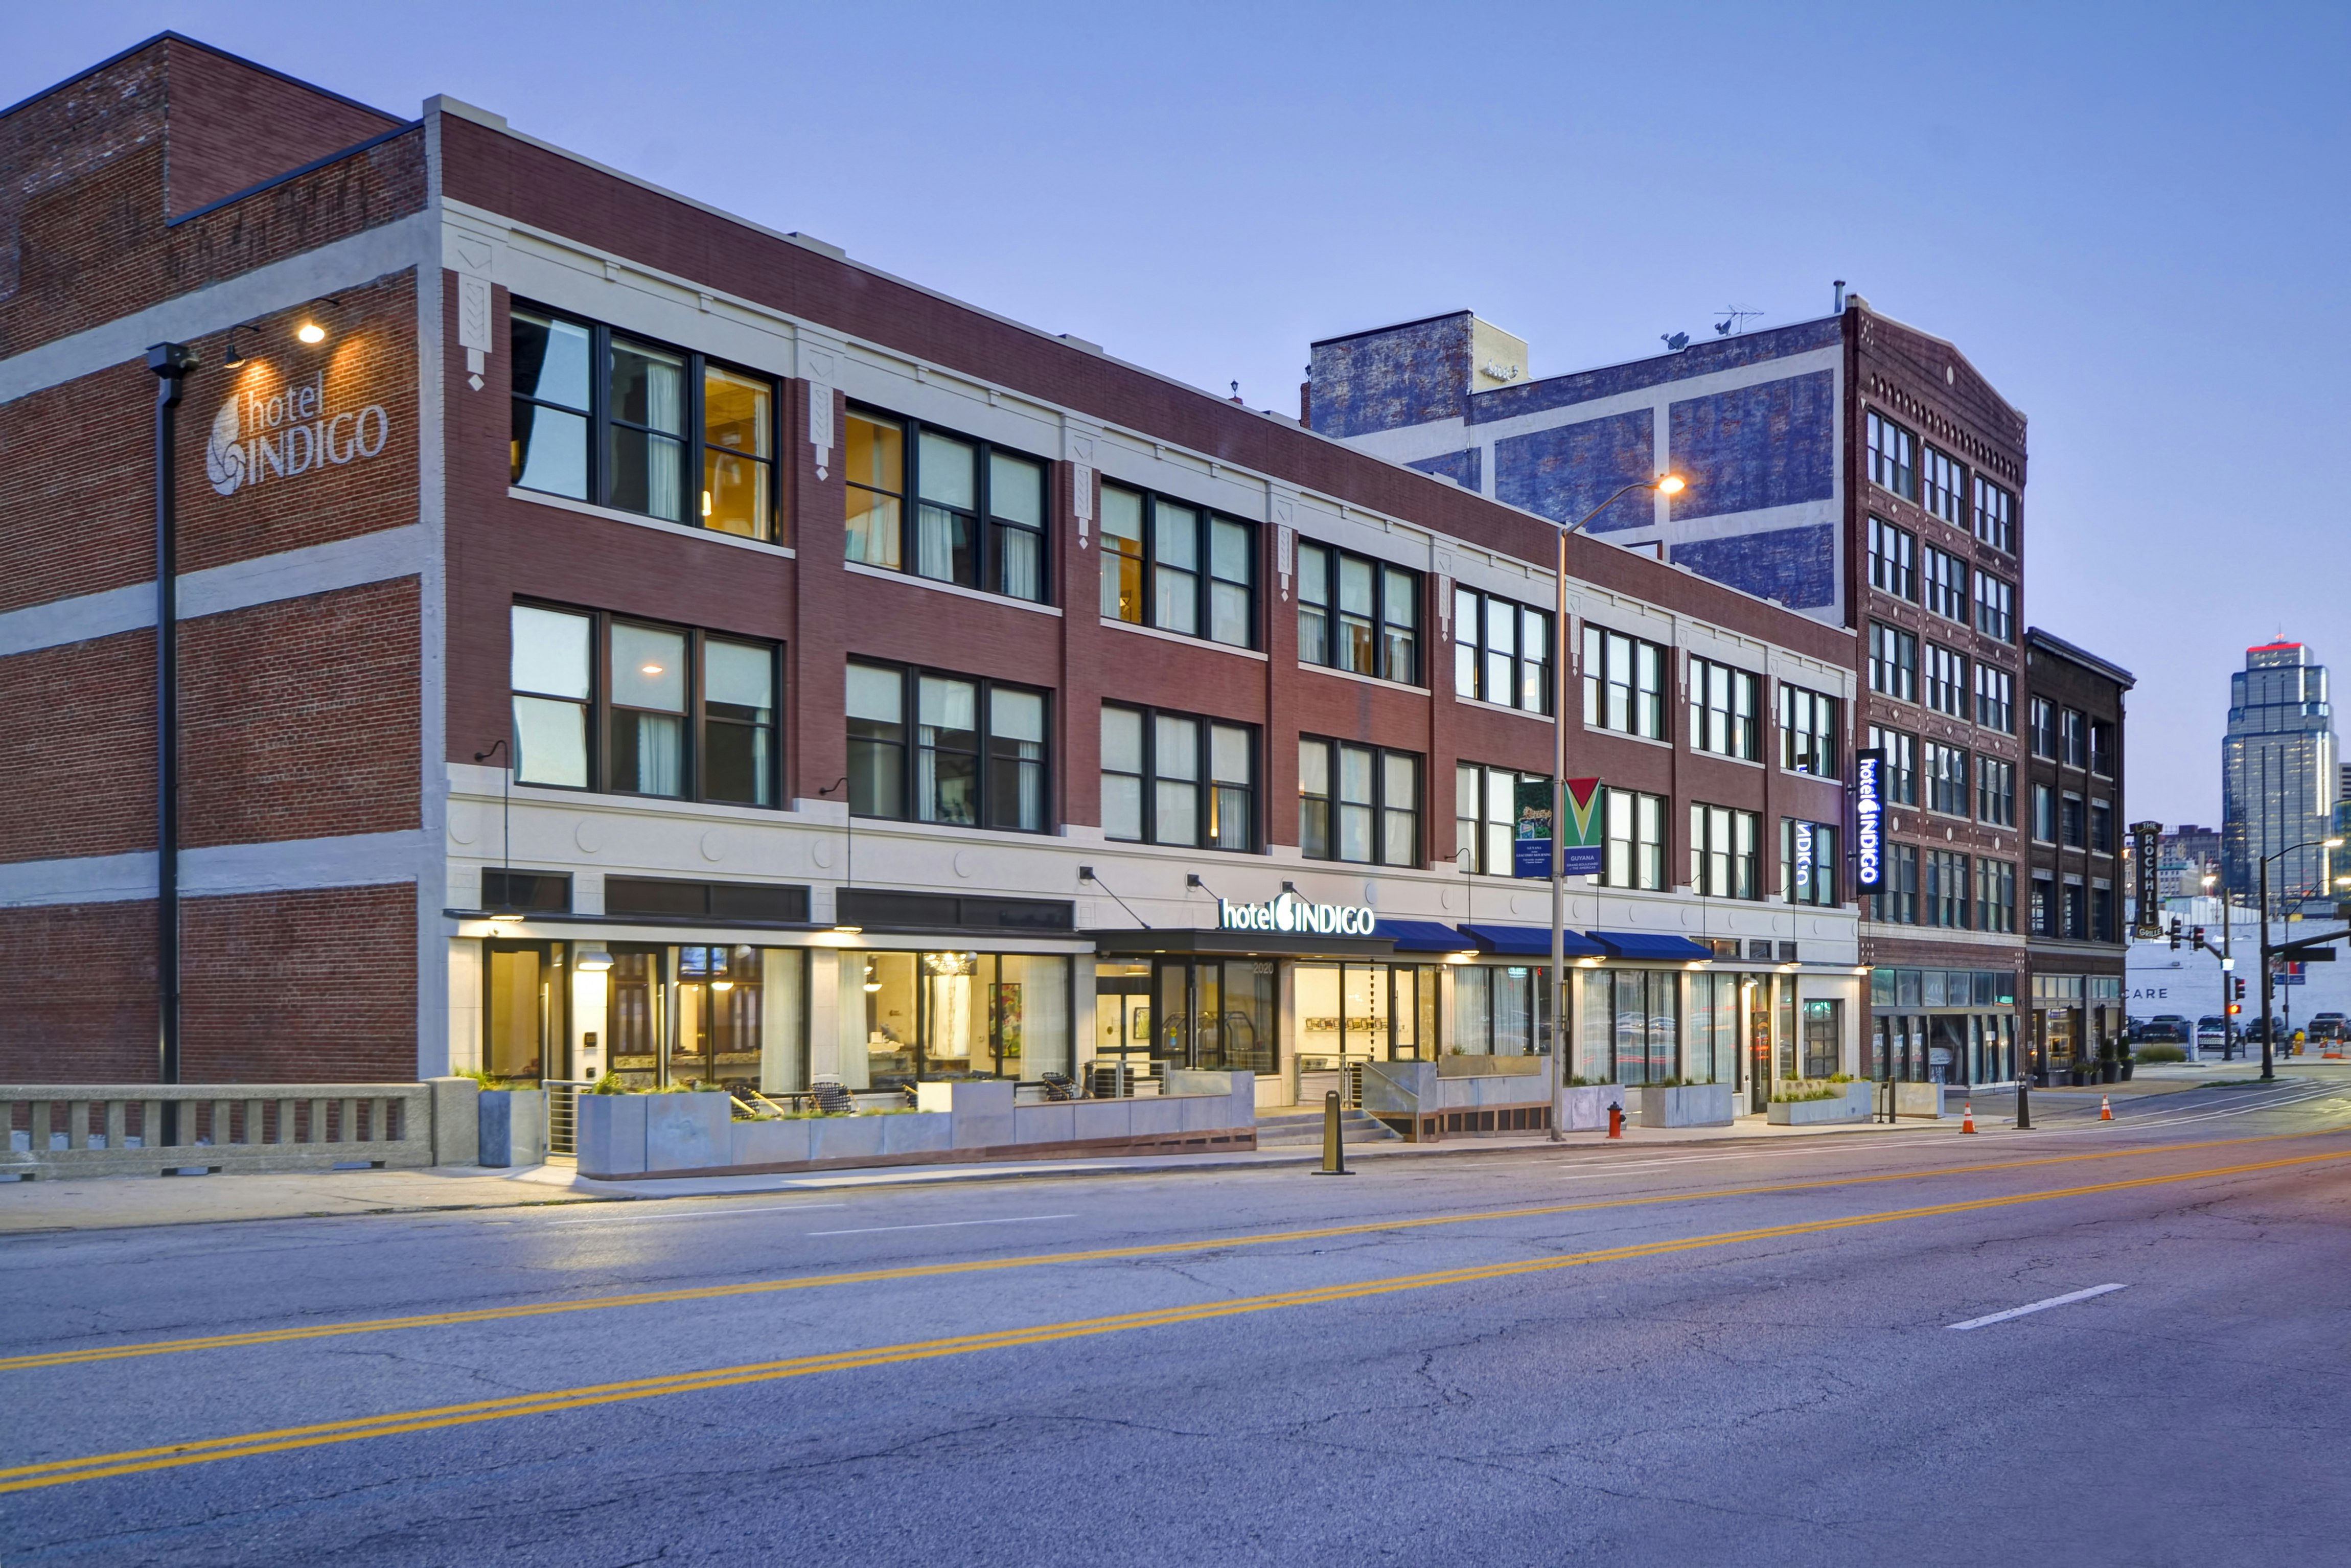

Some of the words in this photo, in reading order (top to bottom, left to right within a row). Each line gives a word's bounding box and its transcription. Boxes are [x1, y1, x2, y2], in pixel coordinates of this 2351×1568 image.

[248, 370, 324, 432] hotel
[248, 404, 389, 485] INDIGO
[1860, 758, 1876, 799] hotel
[1860, 814, 1876, 883] INDIGO
[2145, 834, 2154, 924] ROCKHILL
[1223, 897, 1275, 930] hotel
[1295, 903, 1375, 935] INDIGO
[2139, 928, 2162, 937] GRILLE
[1254, 962, 1274, 974] 2020
